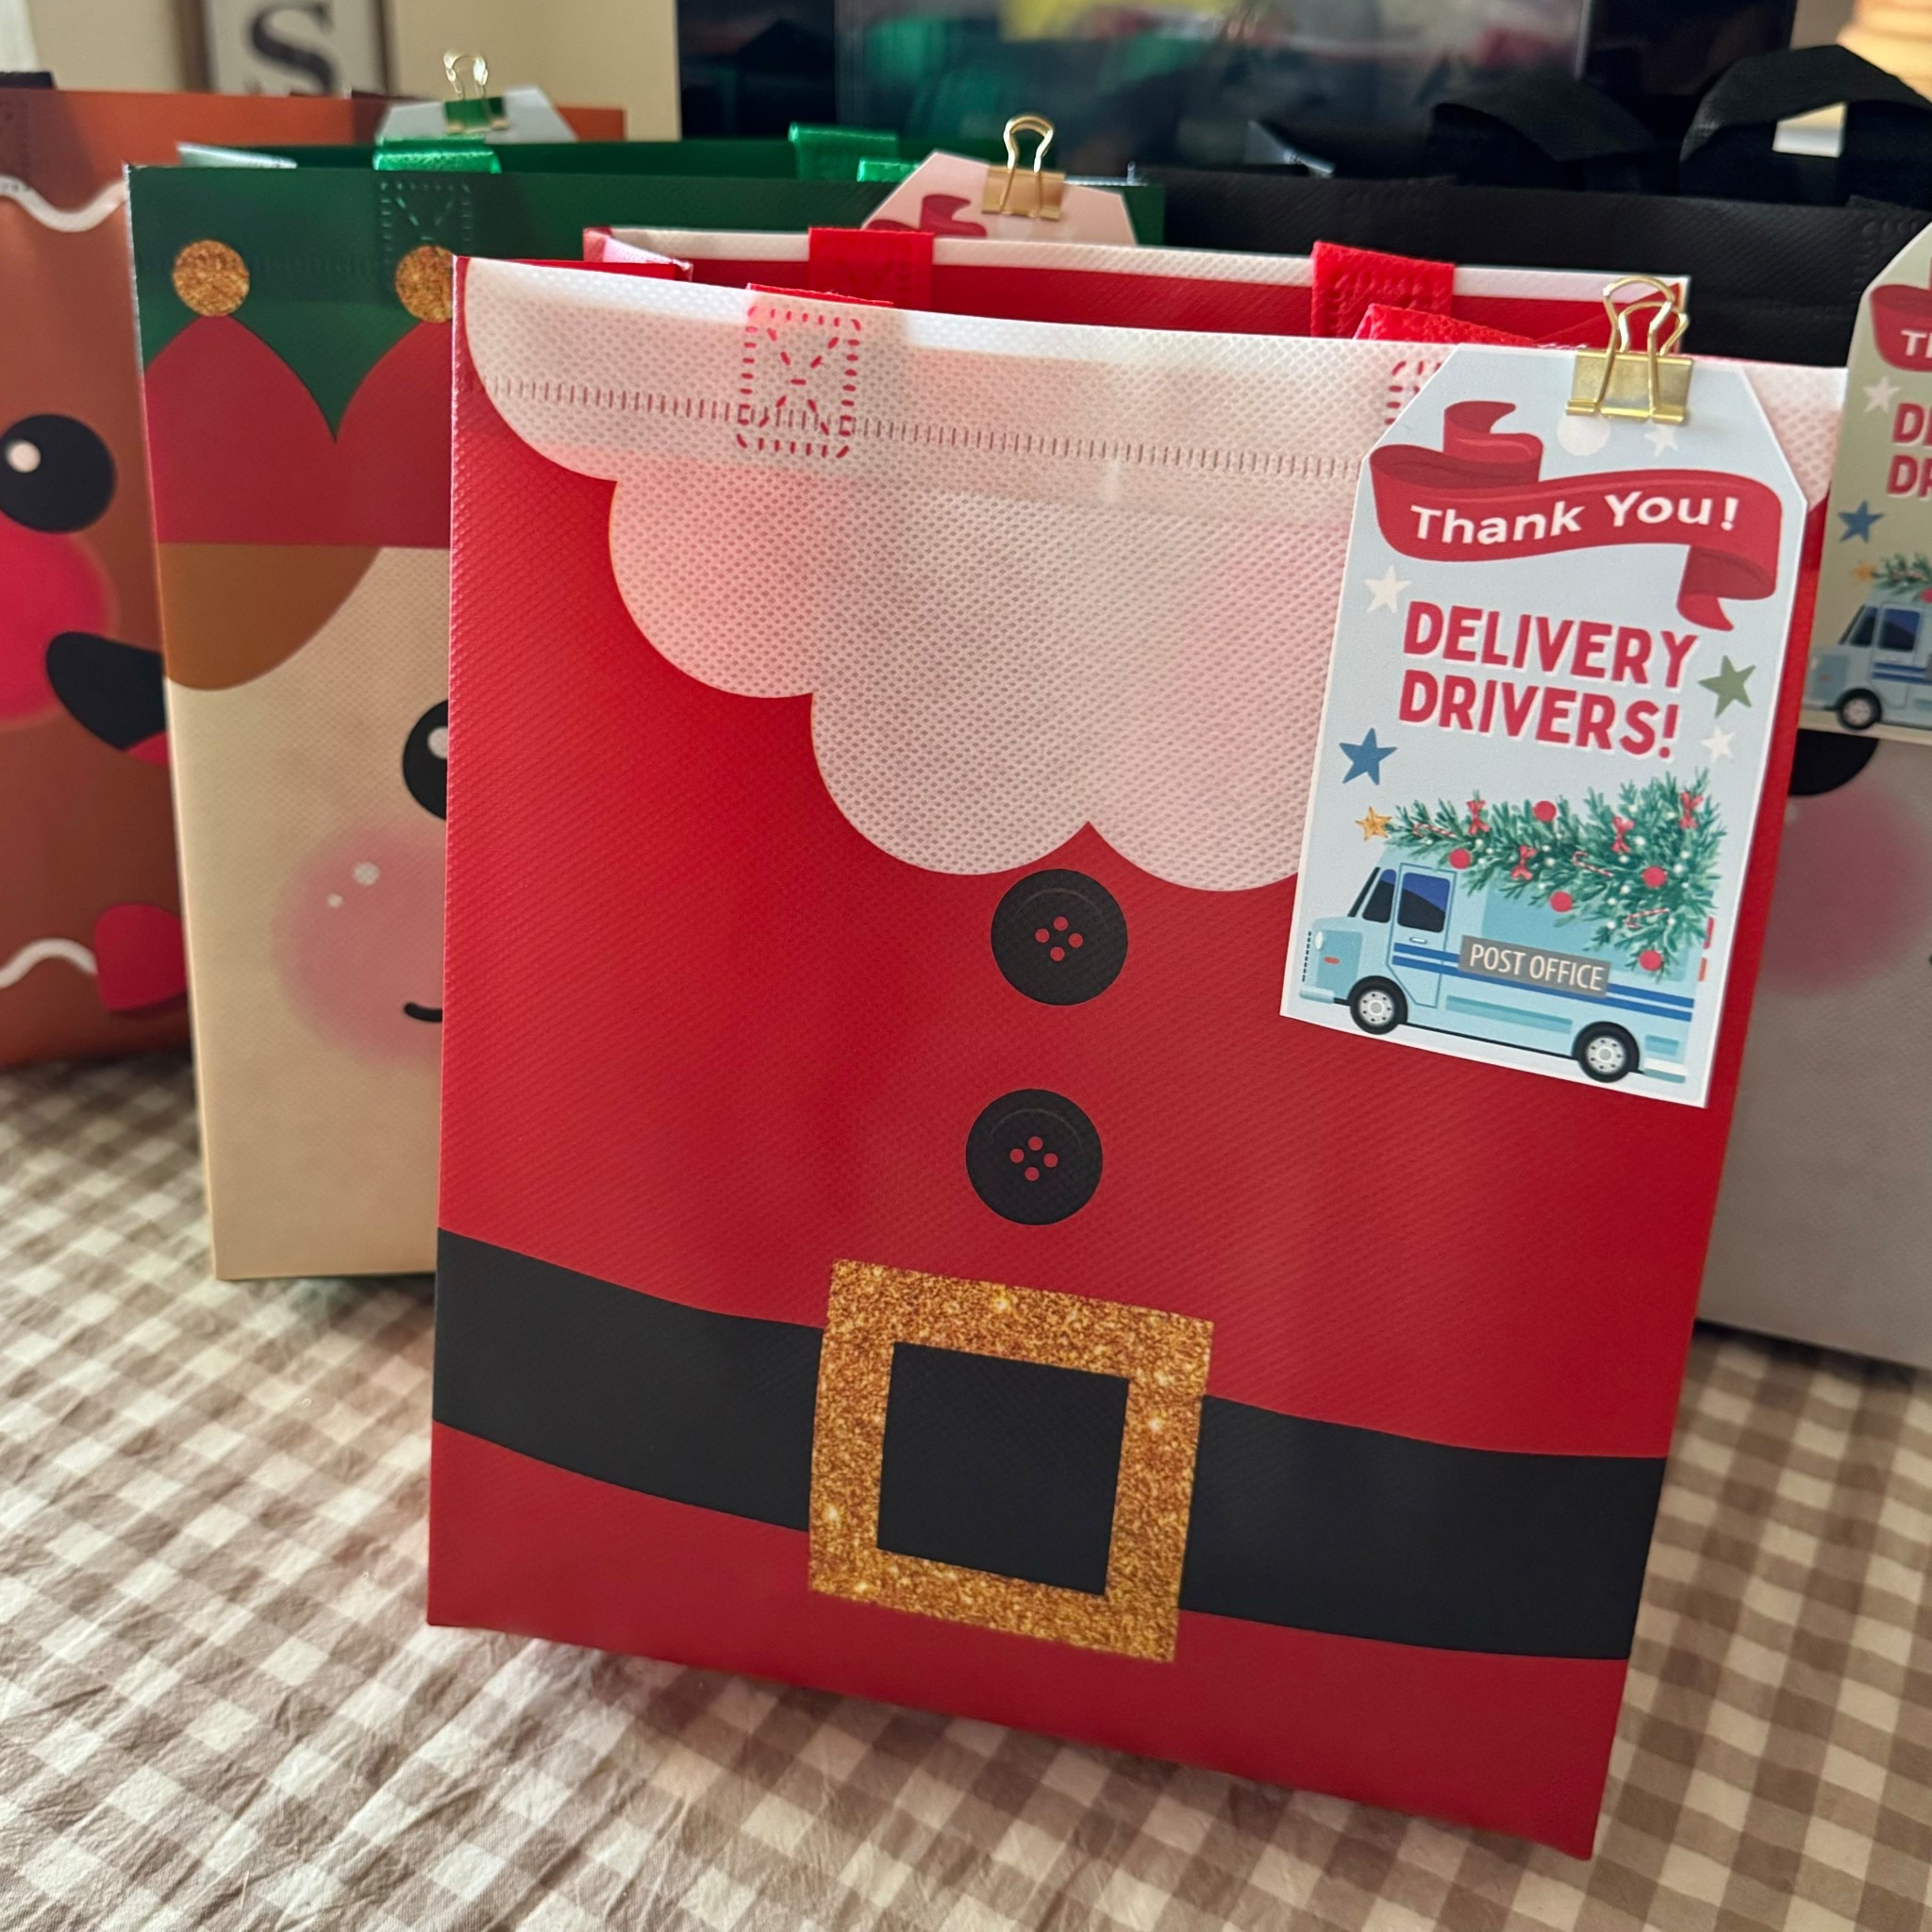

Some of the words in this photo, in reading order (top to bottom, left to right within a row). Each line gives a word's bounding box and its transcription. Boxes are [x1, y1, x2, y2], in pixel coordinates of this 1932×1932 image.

[244, 3, 340, 96] S
[1410, 500, 1586, 545] Thank
[1604, 491, 1739, 532] You!
[1403, 600, 1698, 691] DELIVERY
[1398, 668, 1680, 760] DRIVERS!
[1469, 942, 1526, 975] POST
[1528, 955, 1607, 991] OFFICE
